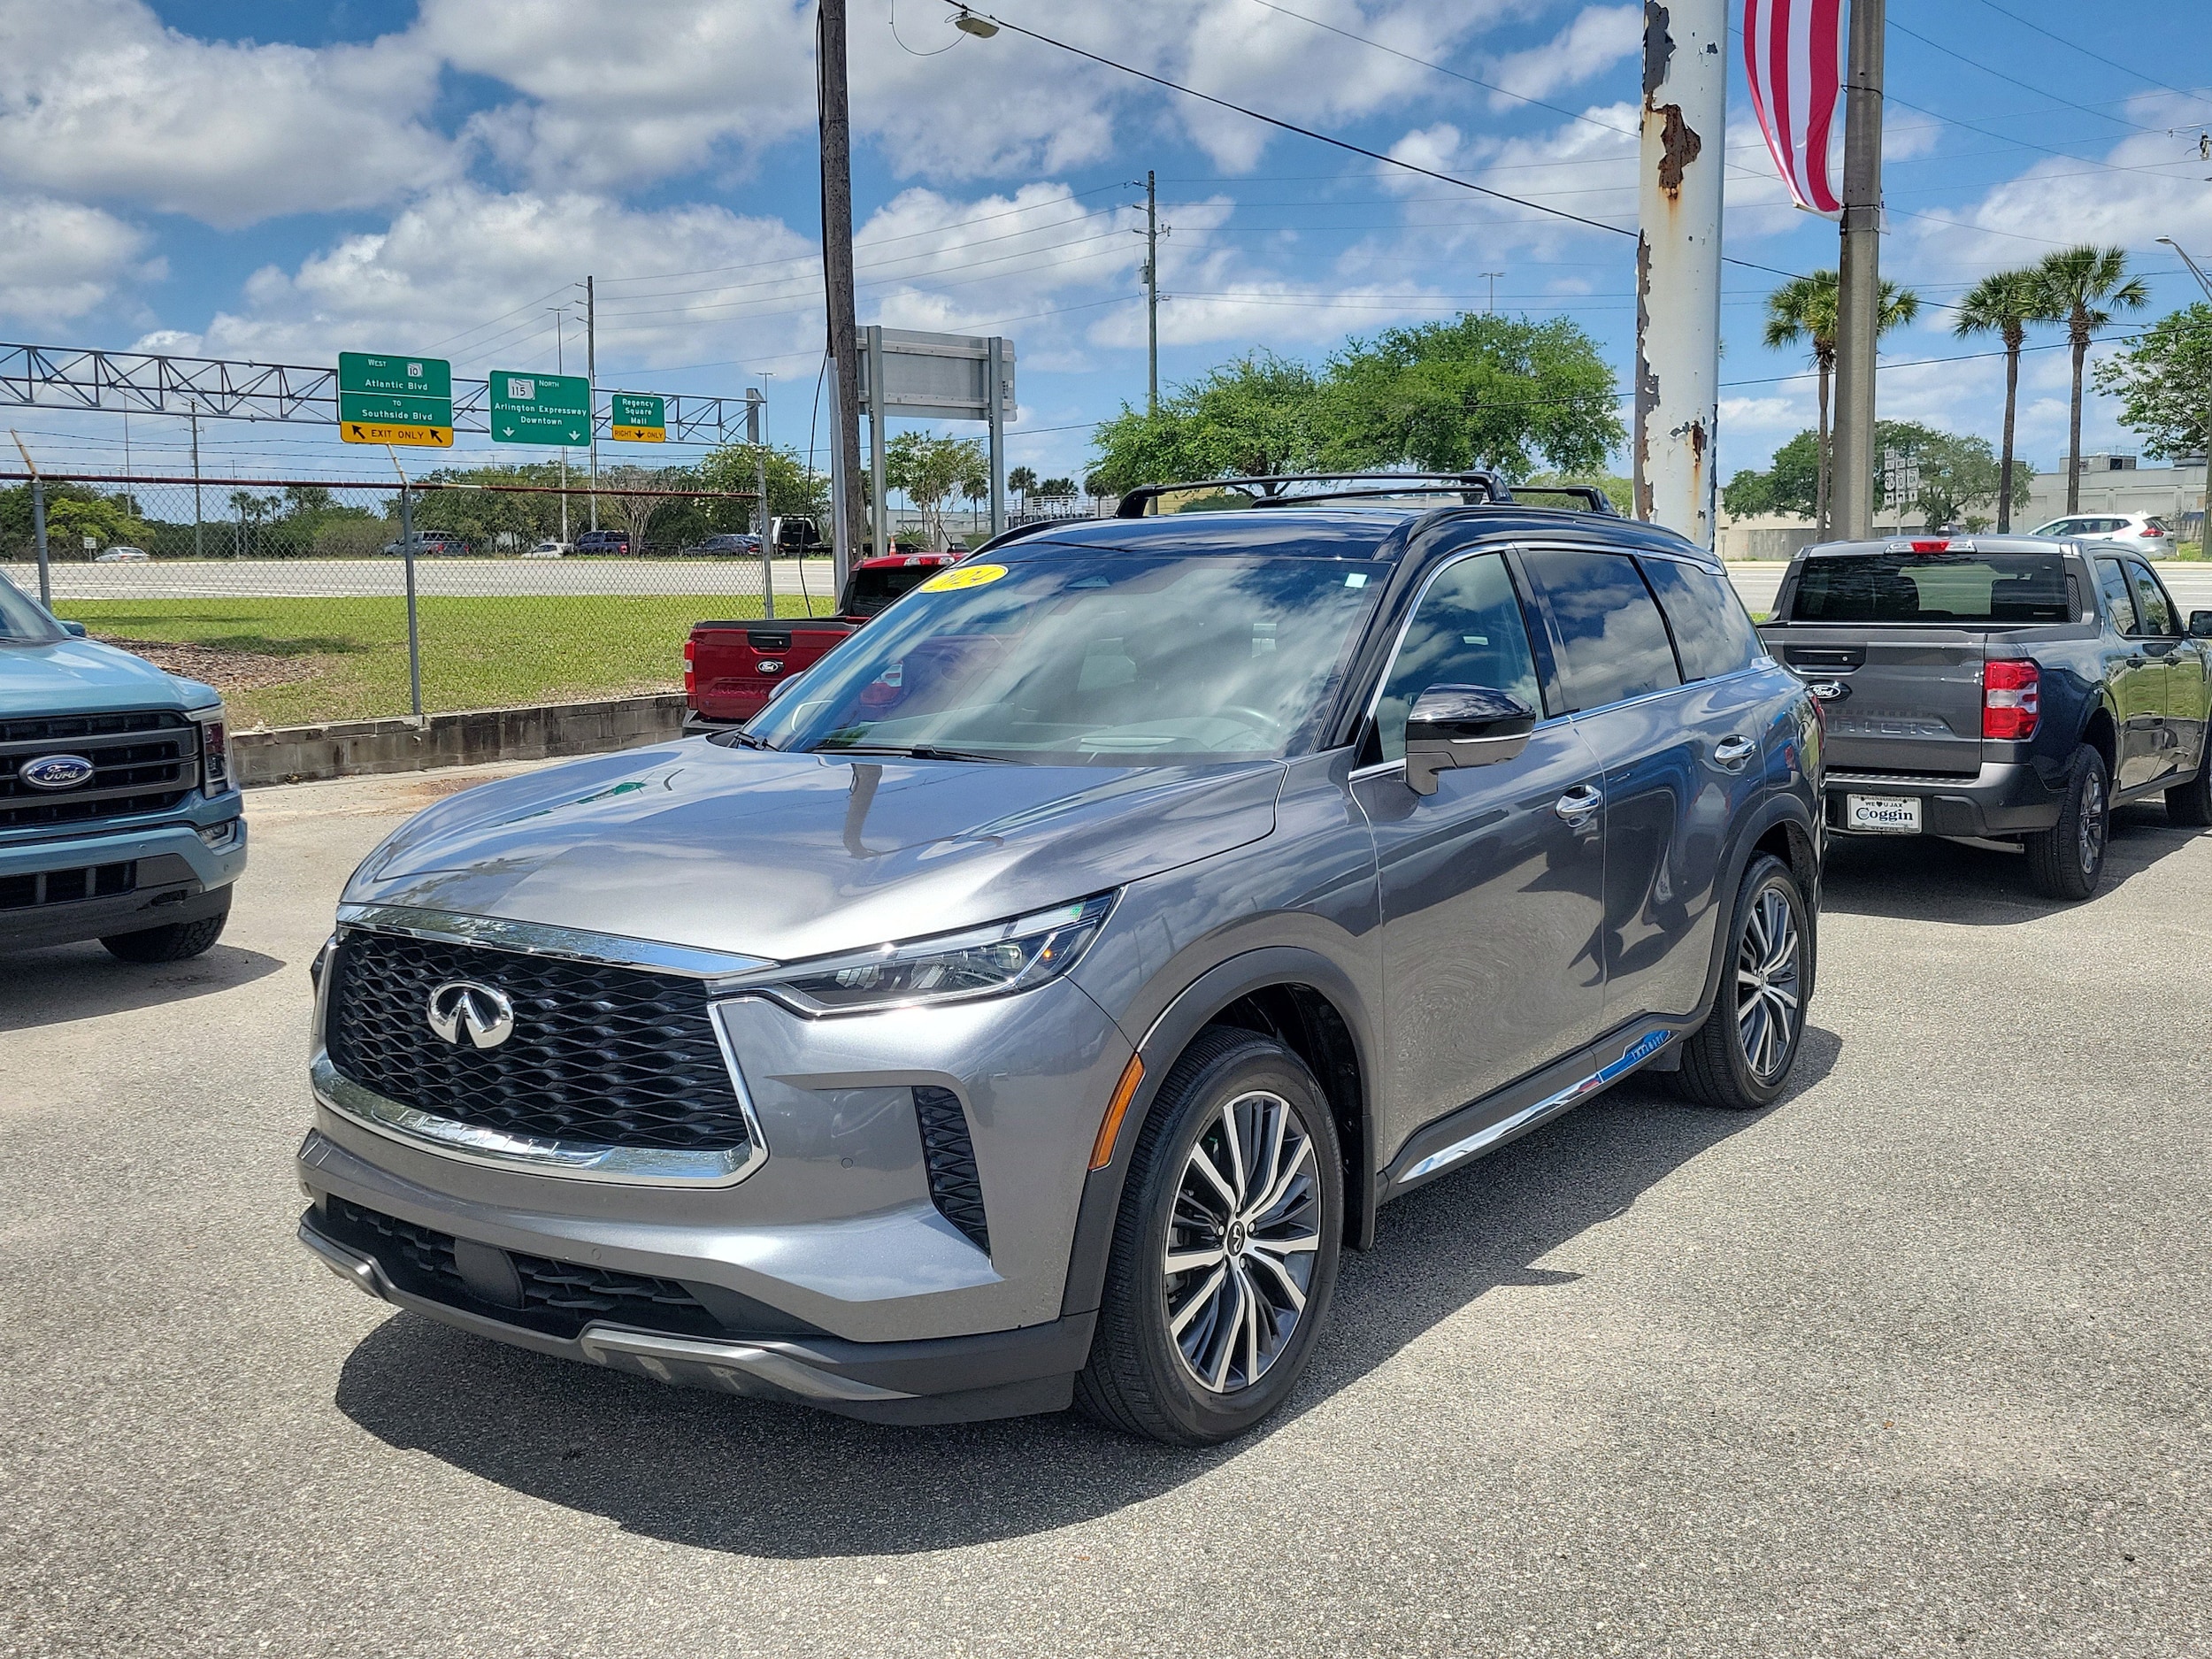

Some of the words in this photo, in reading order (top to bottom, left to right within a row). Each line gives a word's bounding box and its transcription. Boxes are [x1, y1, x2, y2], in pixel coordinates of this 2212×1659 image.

[368, 358, 387, 367] WEST
[365, 379, 403, 388] Atlantic
[408, 381, 428, 390] Blvd
[511, 387, 526, 396] 115
[622, 398, 654, 408] Regency
[362, 409, 409, 419] Southside
[495, 403, 535, 413] Arlington
[538, 405, 587, 417] Expressway
[625, 407, 652, 416] Square
[520, 416, 563, 425] Downtown
[372, 429, 392, 438] EXIT
[398, 430, 424, 439] ONLY
[1813, 687, 1834, 696] Ford
[44, 764, 80, 780] Ford
[1855, 807, 1913, 822] Coggin
